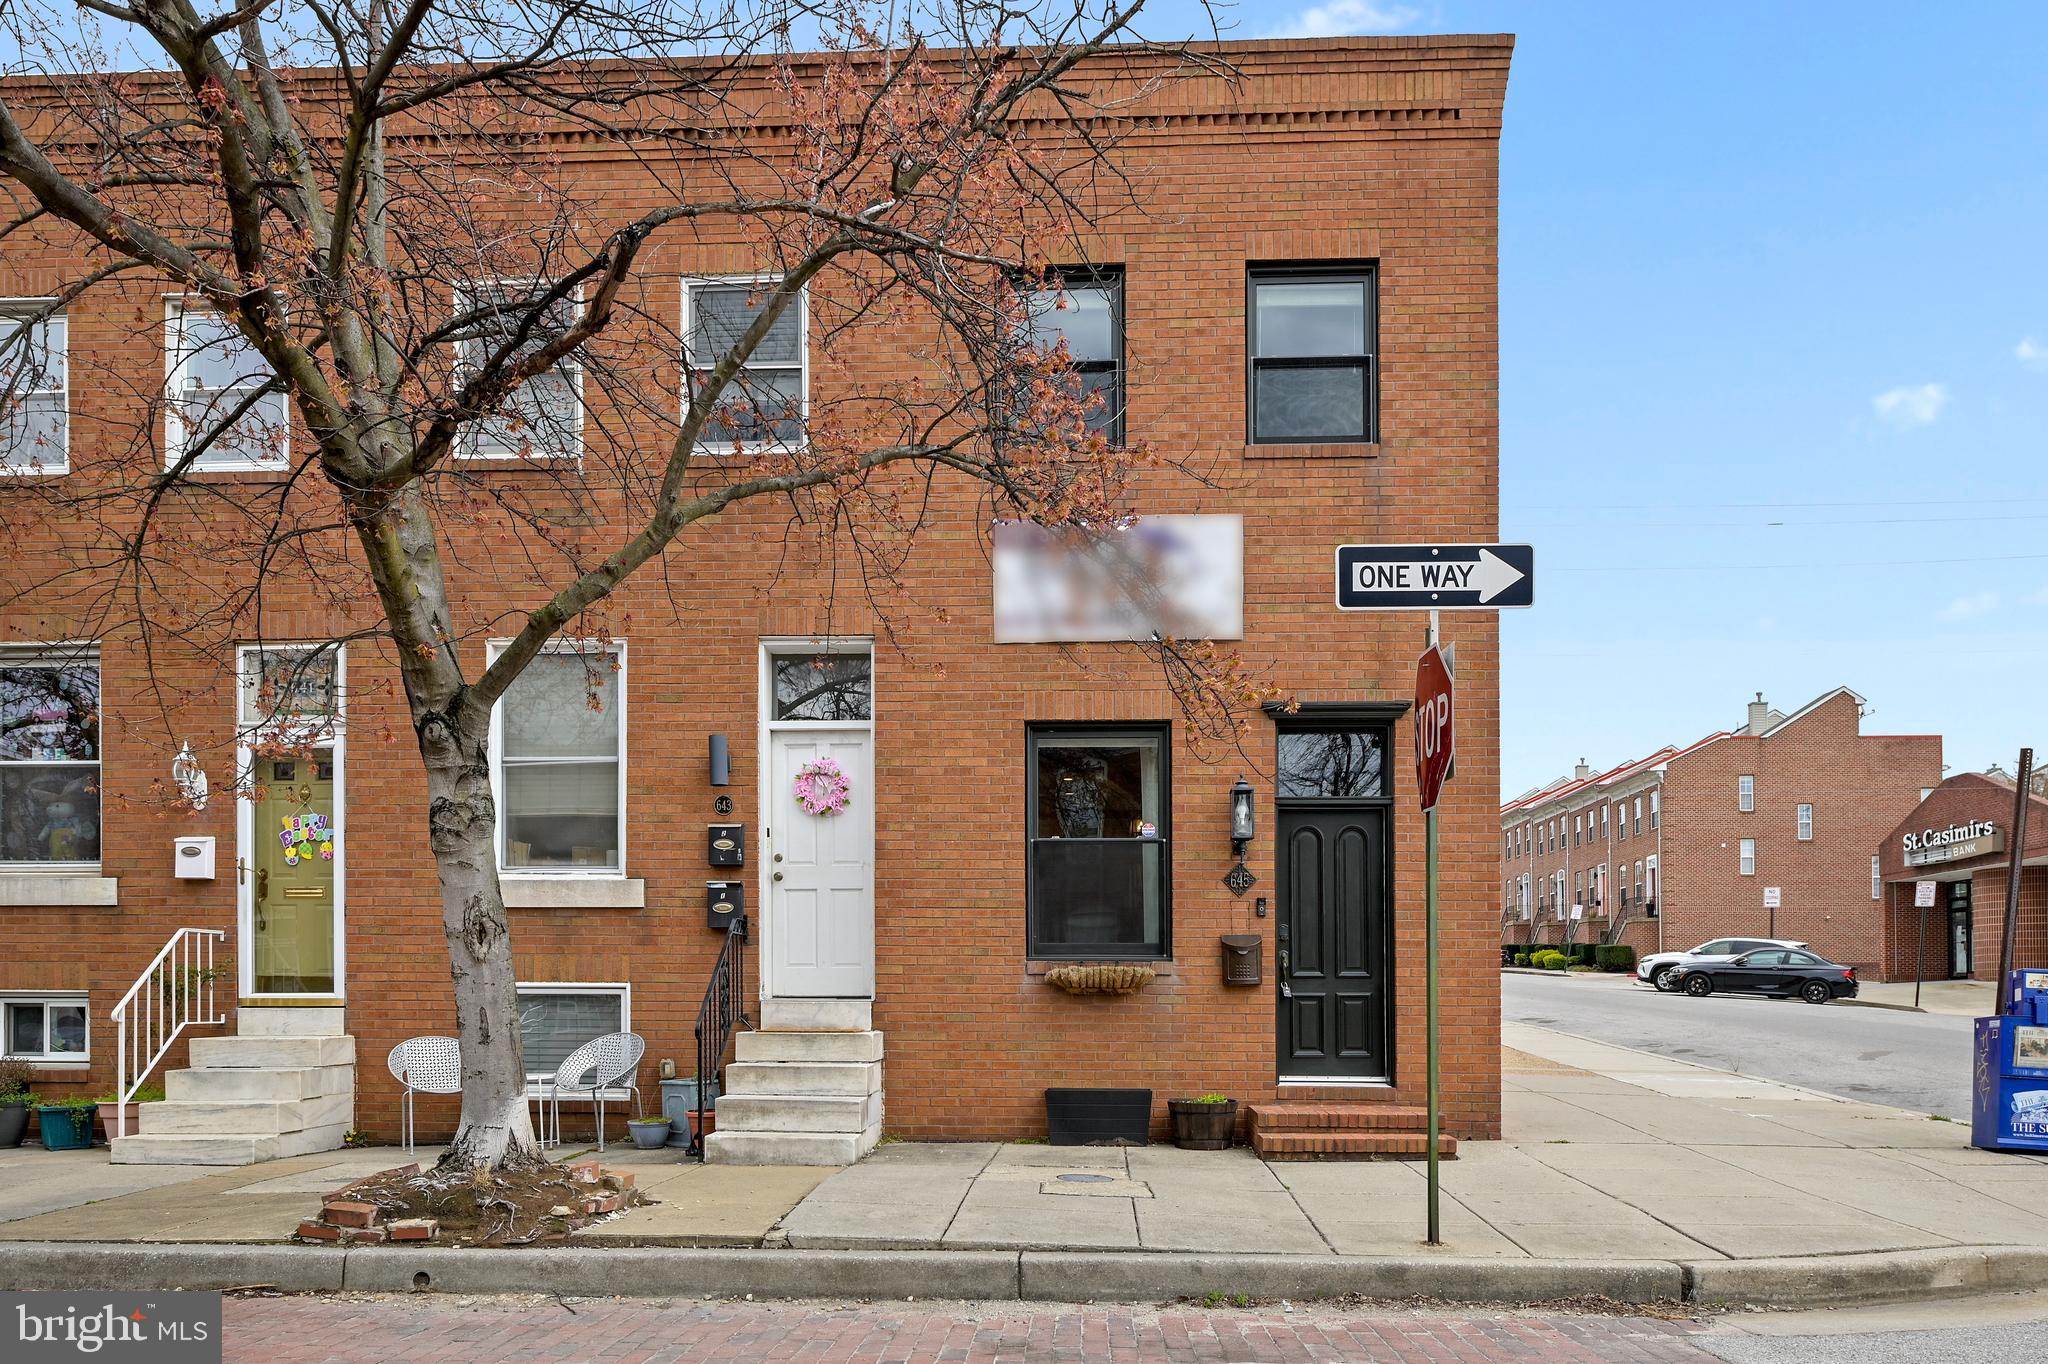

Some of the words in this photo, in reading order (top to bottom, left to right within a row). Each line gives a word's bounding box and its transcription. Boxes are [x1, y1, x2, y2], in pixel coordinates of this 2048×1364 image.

[1359, 565, 1411, 588] ONE
[1421, 565, 1475, 588] WAY
[1415, 693, 1449, 767] STOP
[716, 799, 732, 811] 643
[1953, 843, 1977, 857] BANK
[1230, 872, 1249, 888] 645
[2011, 1122, 2036, 1133] THE
[2038, 1123, 2048, 1134] S
